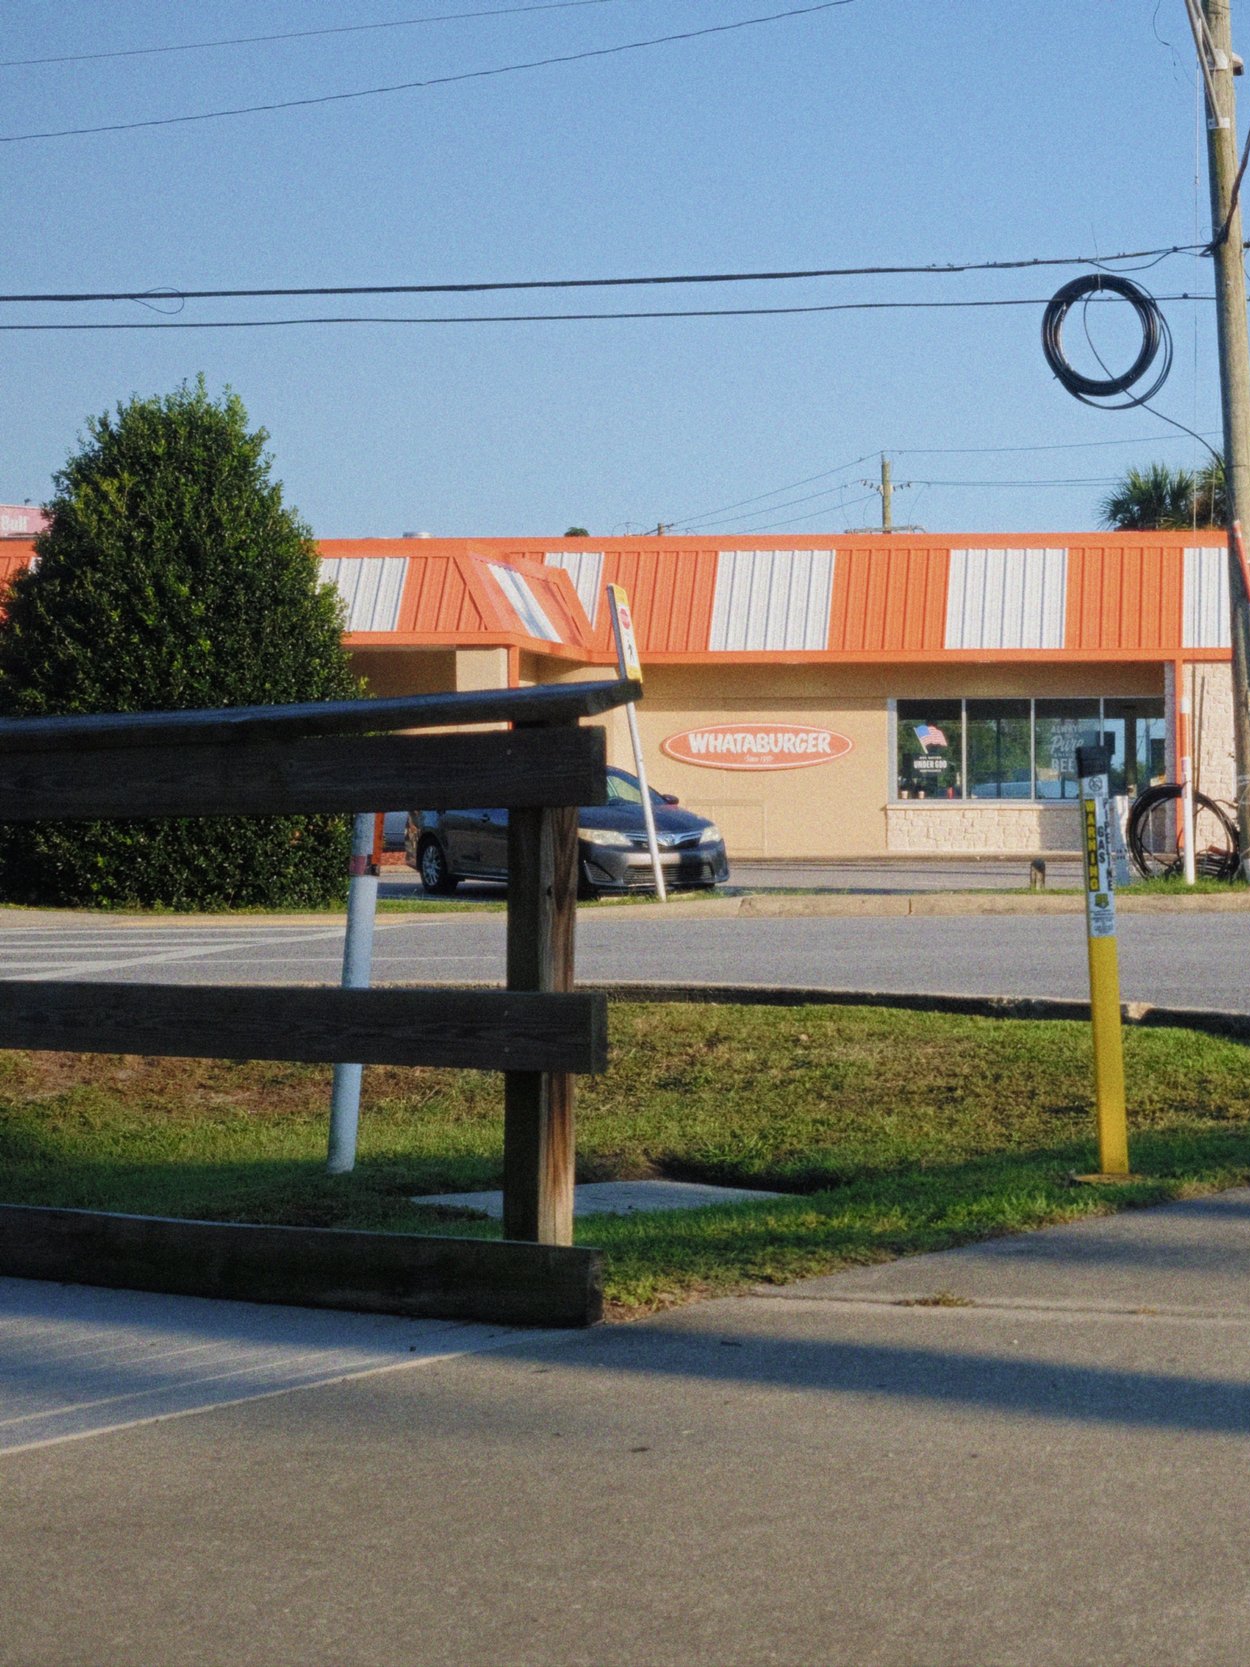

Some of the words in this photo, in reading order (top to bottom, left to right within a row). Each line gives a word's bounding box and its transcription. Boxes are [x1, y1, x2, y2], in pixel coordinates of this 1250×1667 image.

[688, 733, 832, 754] WHATABURGER
[913, 760, 934, 769] UNDER
[935, 760, 947, 769] GOD
[1051, 758, 1077, 772] BEE
[1085, 799, 1099, 891] WARNING
[1097, 826, 1106, 864] GAS
[1103, 798, 1113, 891] PIPELINE
